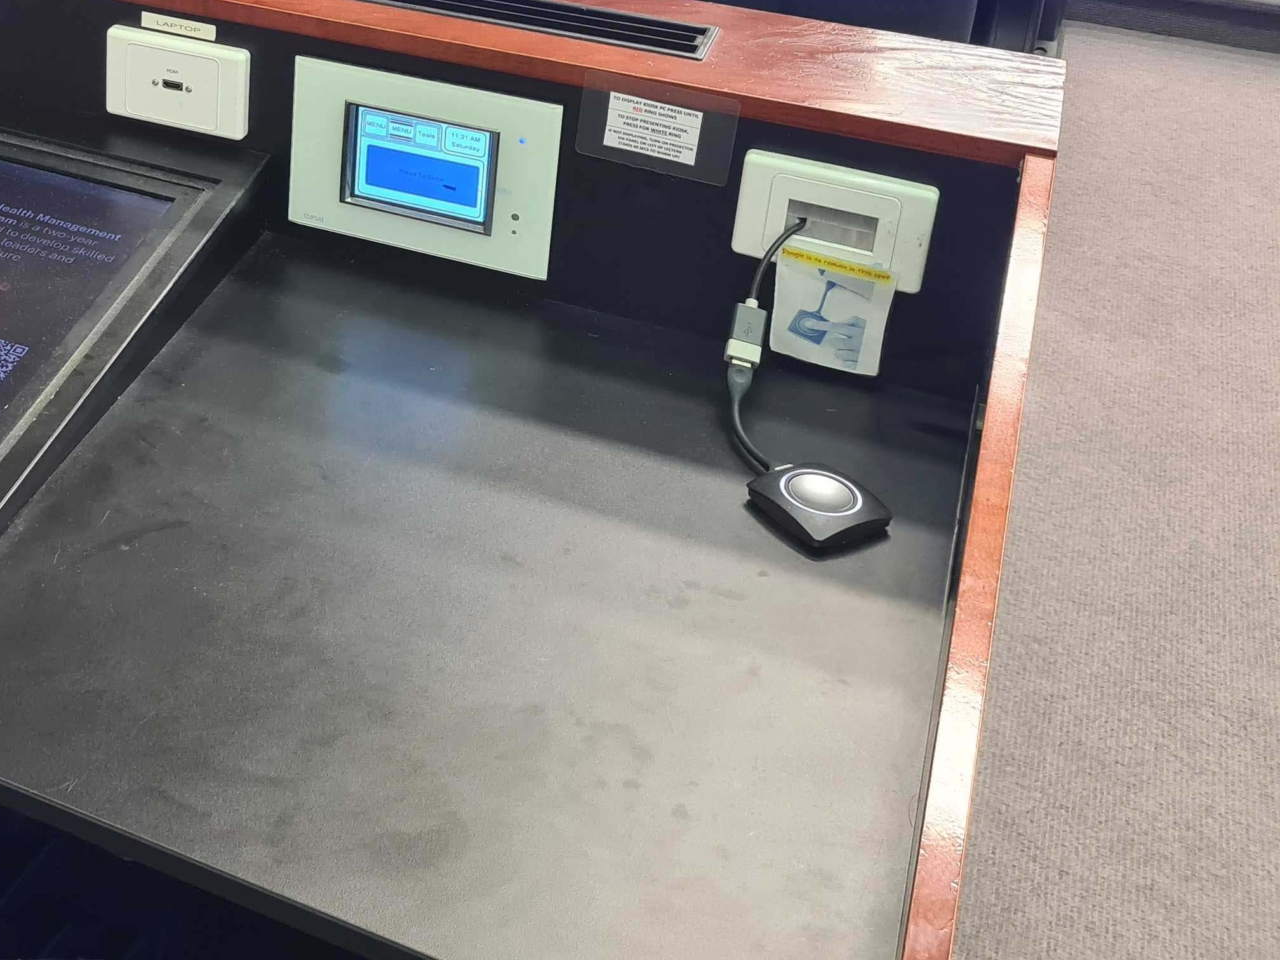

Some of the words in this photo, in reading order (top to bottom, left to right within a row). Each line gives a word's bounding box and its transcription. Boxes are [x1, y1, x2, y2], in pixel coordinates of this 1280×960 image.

[157, 20, 201, 32] LAPTOP
[621, 98, 642, 106] DISPLAY
[667, 107, 683, 115] PRESS
[684, 111, 699, 119] UNTIL
[658, 112, 677, 120] SHOWS
[366, 121, 386, 130] MENU
[392, 126, 412, 135] MENU
[418, 131, 436, 139] Tools
[640, 118, 671, 129] PRESENTING
[672, 126, 689, 134] KIOSK,
[651, 127, 668, 136] WHITE
[451, 142, 480, 153] Saturday
[399, 169, 417, 178] Press
[427, 174, 445, 182] Enter
[19, 220, 29, 229] is
[42, 227, 98, 247] two-year
[36, 213, 121, 241] Management
[1, 237, 47, 257] leaders
[49, 251, 75, 264] and
[6, 228, 18, 238] to
[20, 230, 69, 250] develop
[71, 247, 115, 263] skilled
[783, 248, 804, 258] Dongle
[824, 260, 847, 270] remain
[856, 267, 872, 276] this
[873, 272, 891, 280] spot
